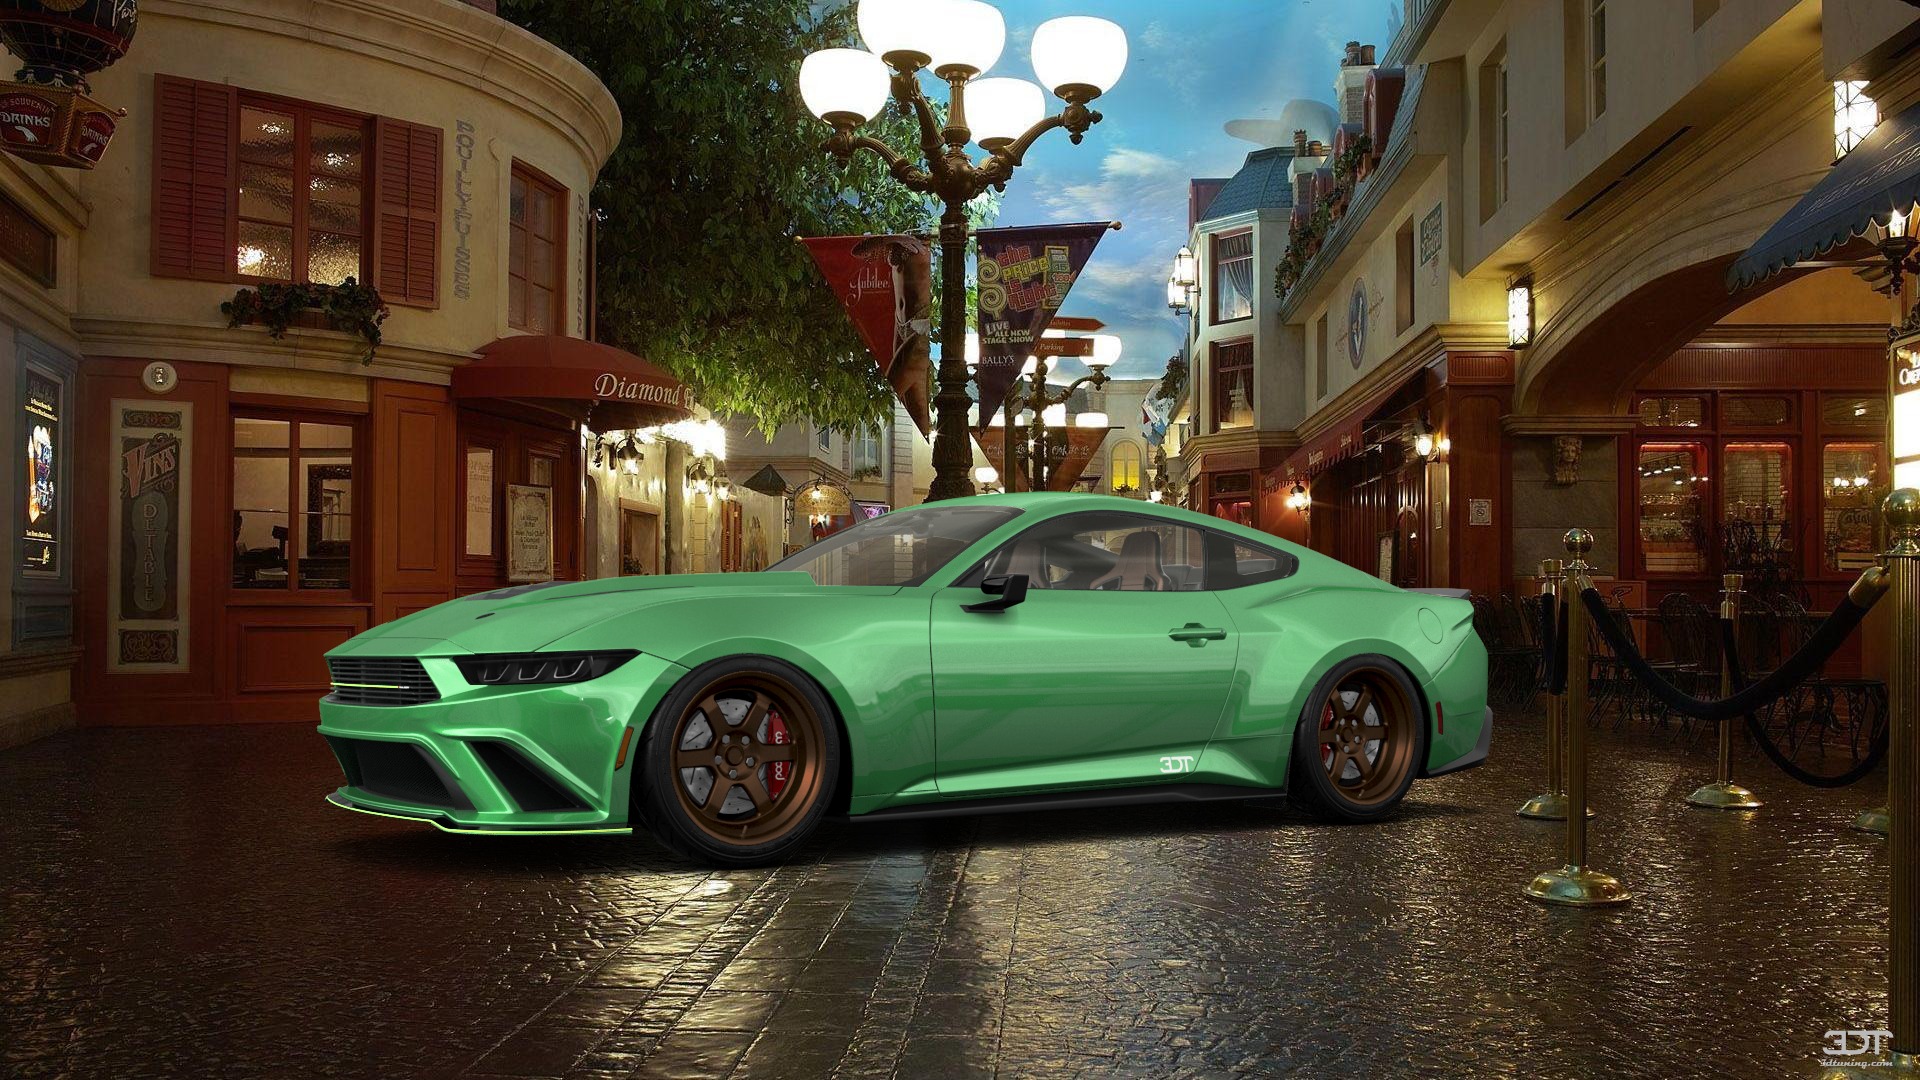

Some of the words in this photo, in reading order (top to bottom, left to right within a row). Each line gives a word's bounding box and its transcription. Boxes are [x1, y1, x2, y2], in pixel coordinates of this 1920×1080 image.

[0, 111, 51, 128] DRINKS
[81, 125, 109, 145] DRINKS
[985, 321, 1009, 335] LIVE
[1011, 329, 1030, 337] NEW
[983, 337, 1007, 345] STAGE
[1009, 336, 1034, 344] SHOW
[1039, 343, 1065, 352] Parking
[982, 355, 1015, 365] BALLY'S
[595, 373, 683, 405] Diamond
[1160, 755, 1194, 774] 3DT
